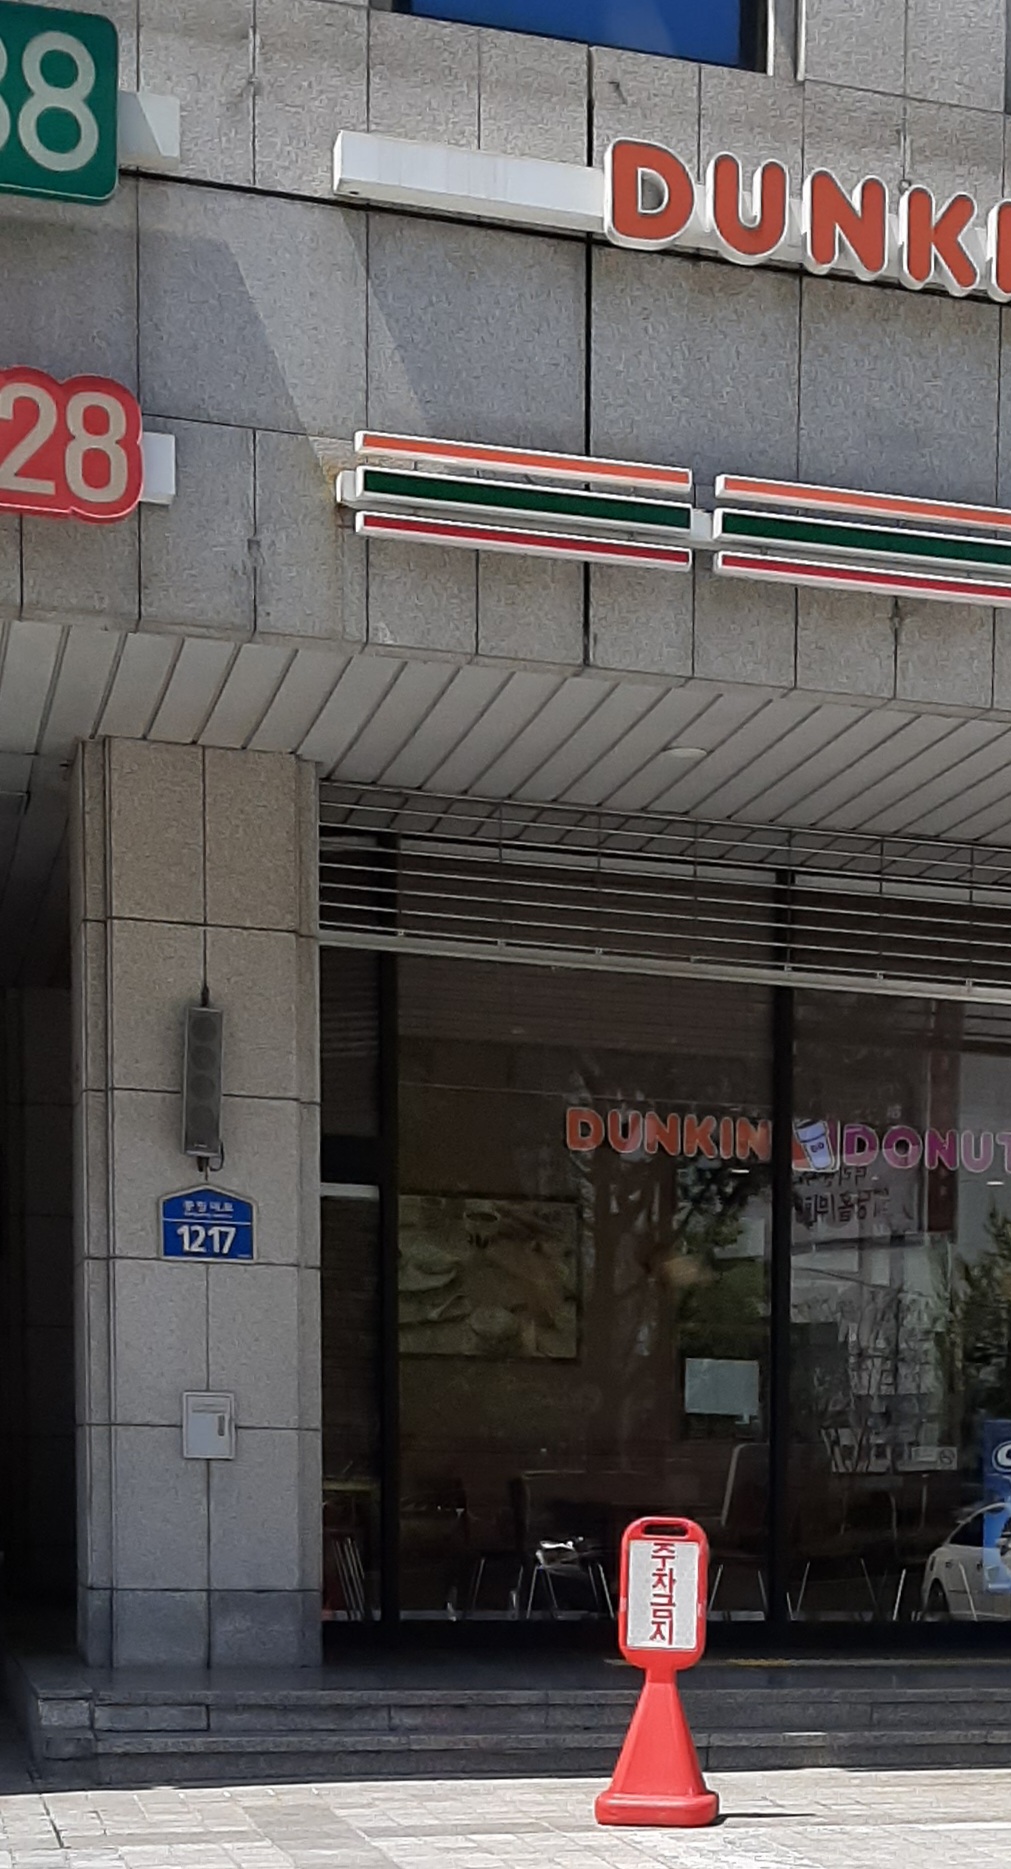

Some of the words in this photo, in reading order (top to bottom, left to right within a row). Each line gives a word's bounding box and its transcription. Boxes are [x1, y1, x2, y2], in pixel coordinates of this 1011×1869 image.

[0, 30, 98, 172] 8
[176, 1224, 237, 1254] 1217
[649, 1542, 676, 1646] 주차금지
